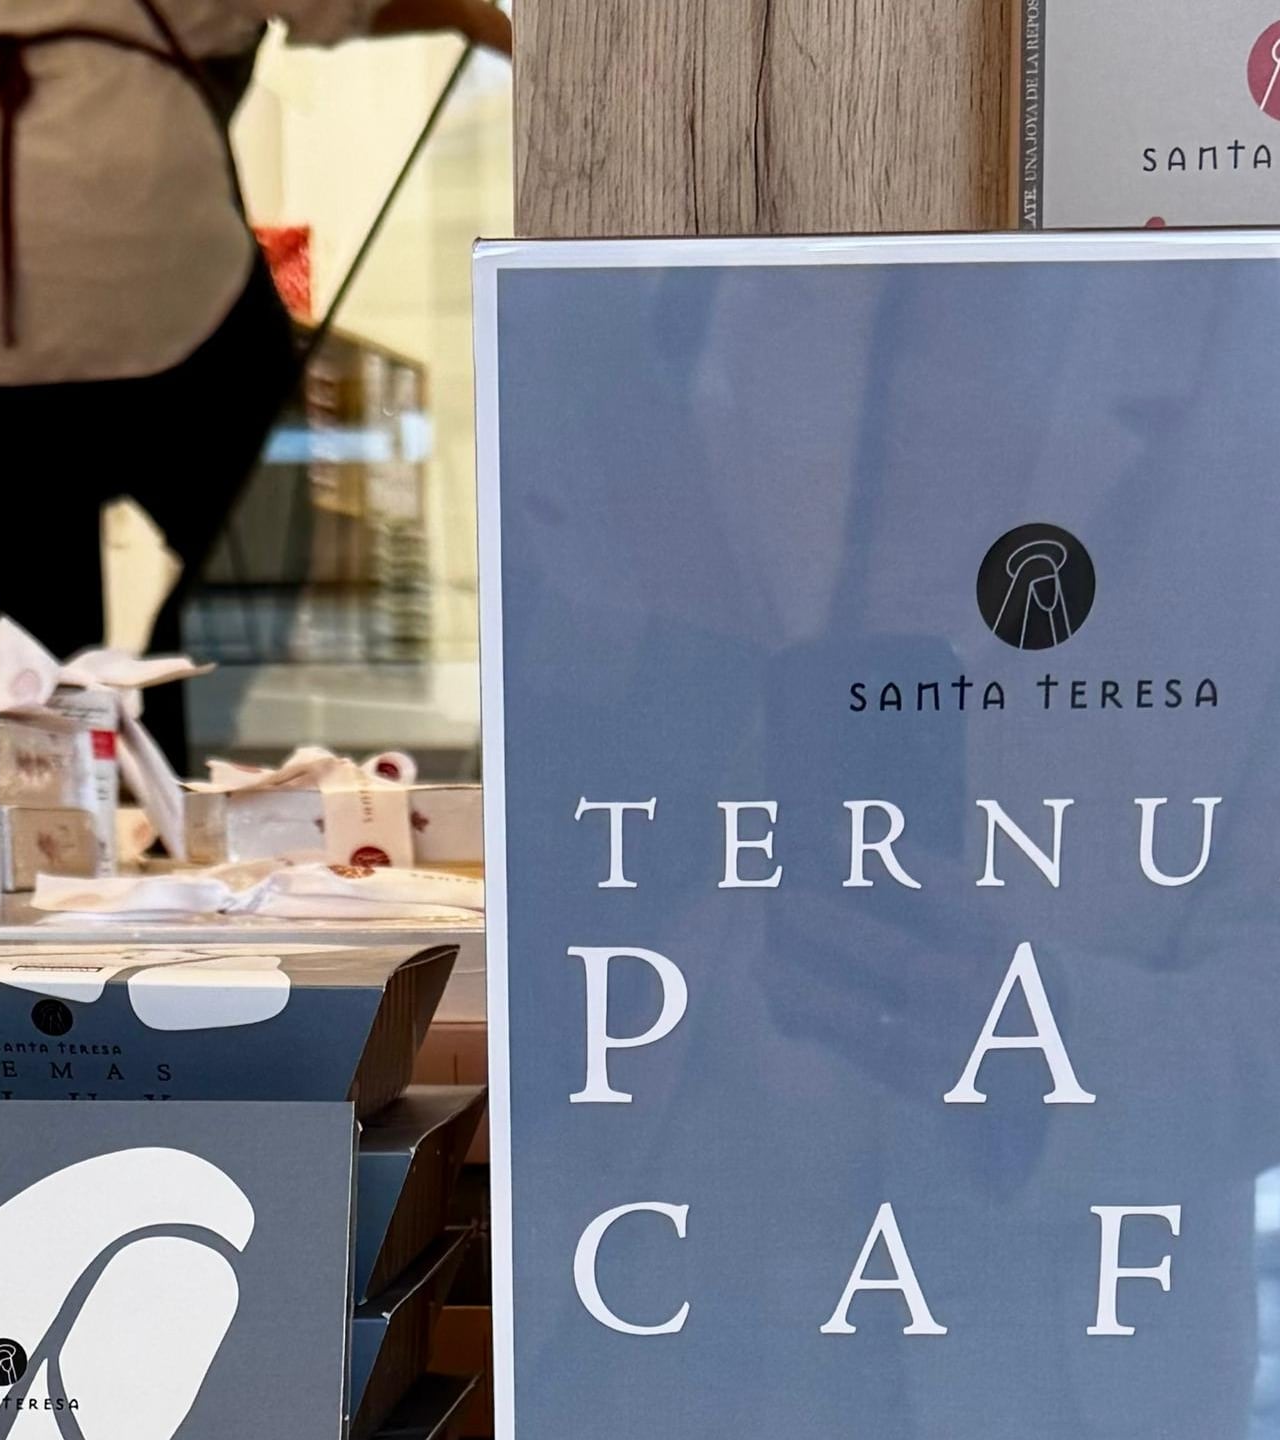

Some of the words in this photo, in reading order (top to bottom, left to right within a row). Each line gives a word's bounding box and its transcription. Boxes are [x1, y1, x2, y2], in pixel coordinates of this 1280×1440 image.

[1026, 53, 1039, 75] LA
[1026, 78, 1038, 100] DE
[1143, 140, 1272, 172] SANTA
[850, 674, 1005, 712] SANTA
[1036, 673, 1219, 710] TERESA
[57, 1042, 122, 1056] TERESA
[1, 1395, 80, 1412] TERESA
